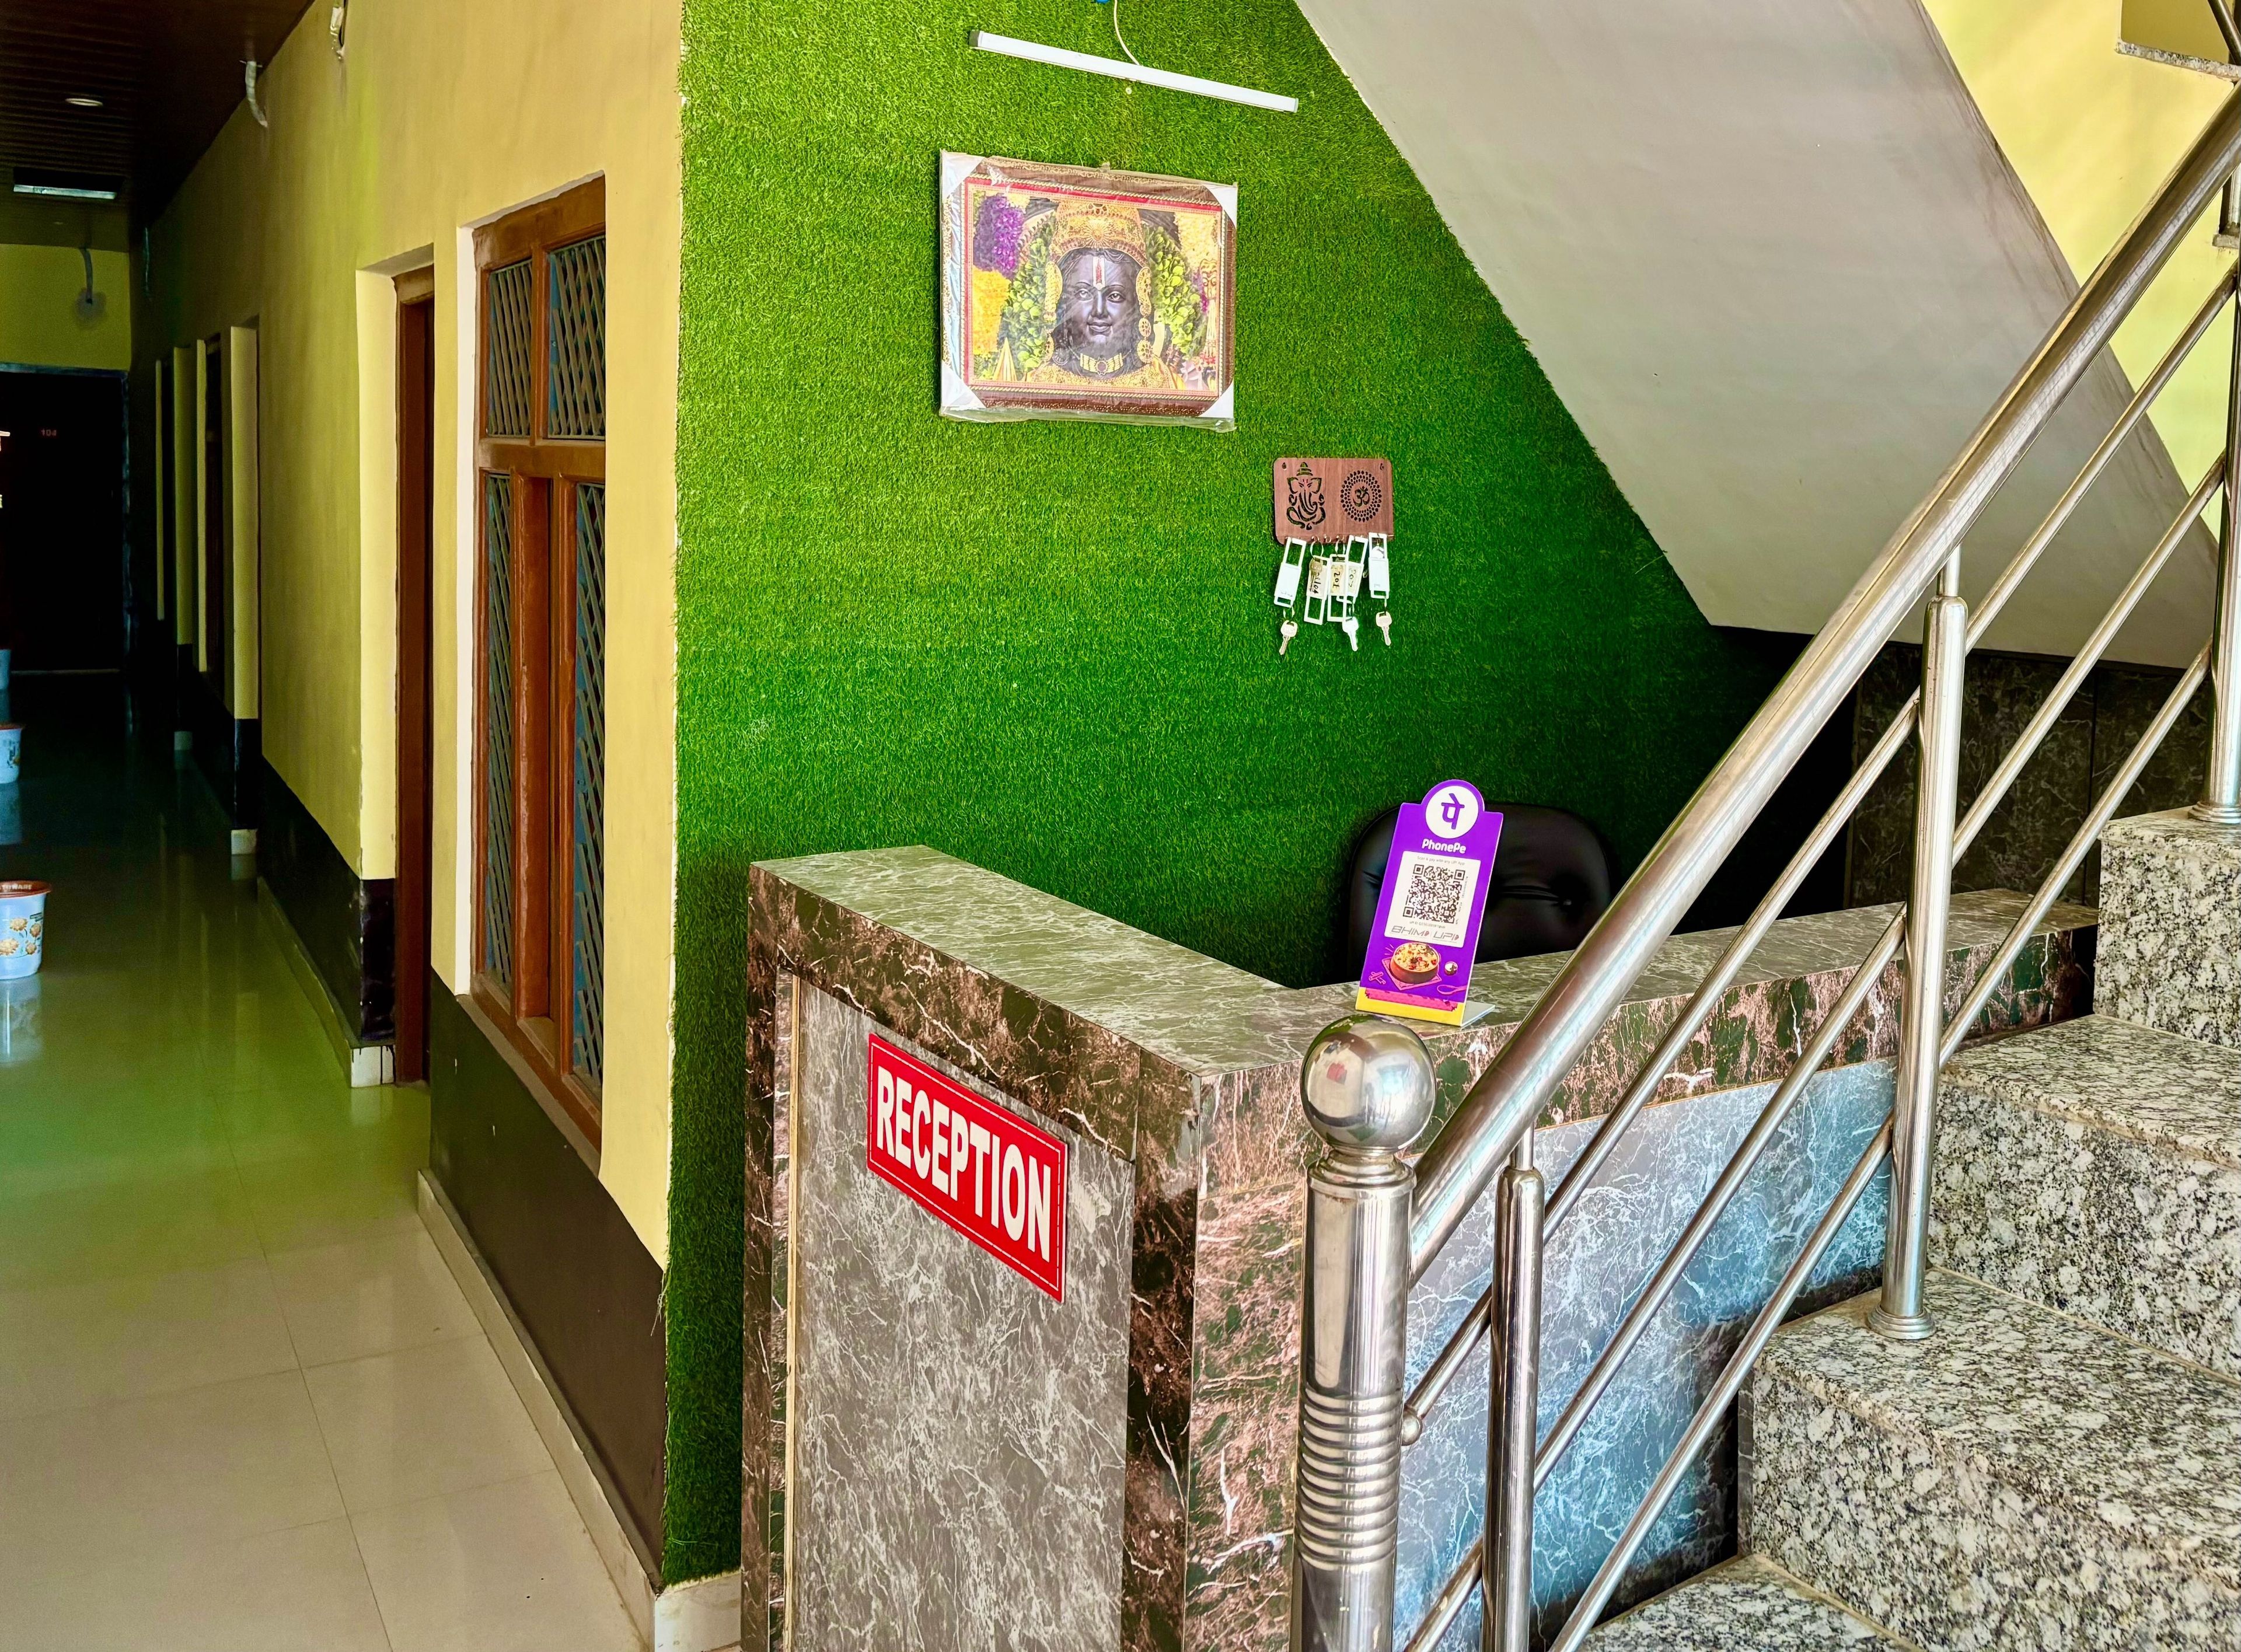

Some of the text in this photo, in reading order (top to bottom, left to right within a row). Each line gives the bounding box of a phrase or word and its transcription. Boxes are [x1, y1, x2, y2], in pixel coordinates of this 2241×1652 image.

[1332, 571, 1341, 588] 201
[1441, 792, 1465, 829] पे
[1422, 839, 1467, 854] PhonePe
[1391, 925, 1425, 937] BHIM
[1433, 931, 1455, 941] UPI
[877, 1065, 1051, 1263] RECEPTION
